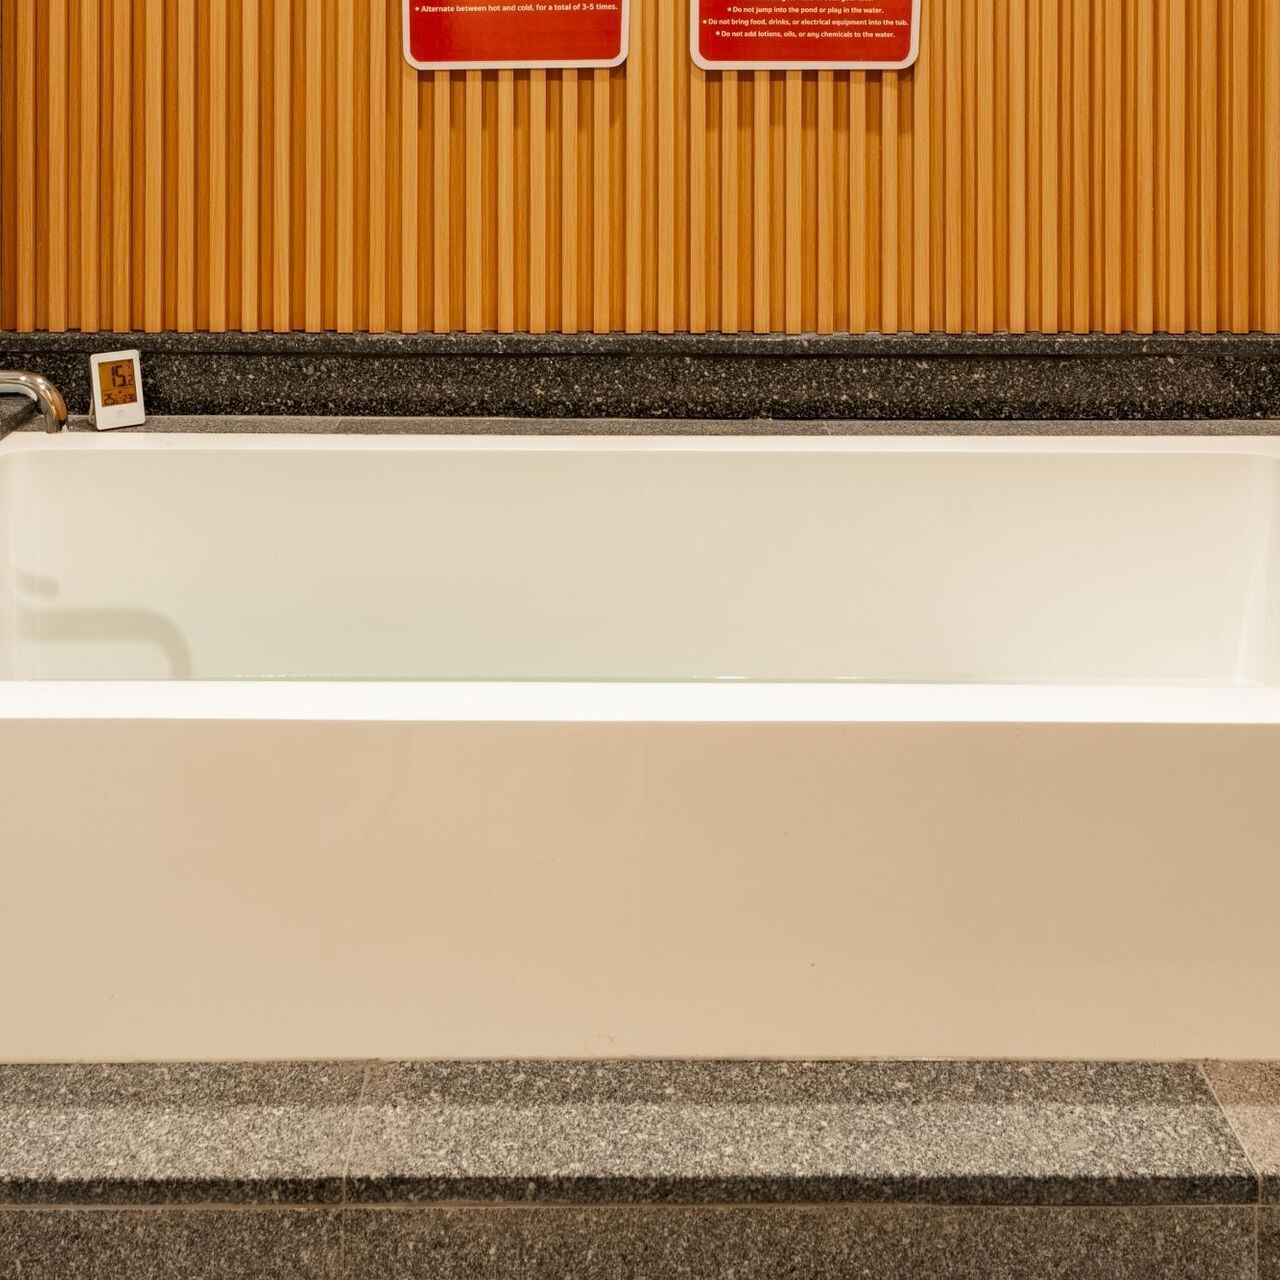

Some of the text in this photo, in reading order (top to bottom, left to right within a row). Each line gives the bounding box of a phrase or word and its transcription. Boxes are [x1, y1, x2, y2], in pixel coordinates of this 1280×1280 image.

[456, 4, 487, 12] between
[488, 4, 501, 12] hot
[502, 4, 516, 12] and
[517, 3, 535, 12] cold,
[536, 3, 547, 11] for
[554, 3, 572, 11] total
[582, 3, 595, 11] 3-5
[595, 2, 618, 10] times.
[755, 6, 773, 14] jump
[800, 6, 818, 14] pond
[827, 6, 842, 15] play
[850, 6, 862, 14] the
[731, 18, 750, 26] bring
[750, 18, 768, 26] food,
[768, 18, 791, 26] drinks,
[800, 18, 831, 26] electrical
[831, 18, 867, 27] equipment
[758, 30, 782, 38] lotions,
[783, 30, 798, 38] oils,
[806, 31, 820, 39] any
[820, 30, 853, 38] chemicals
